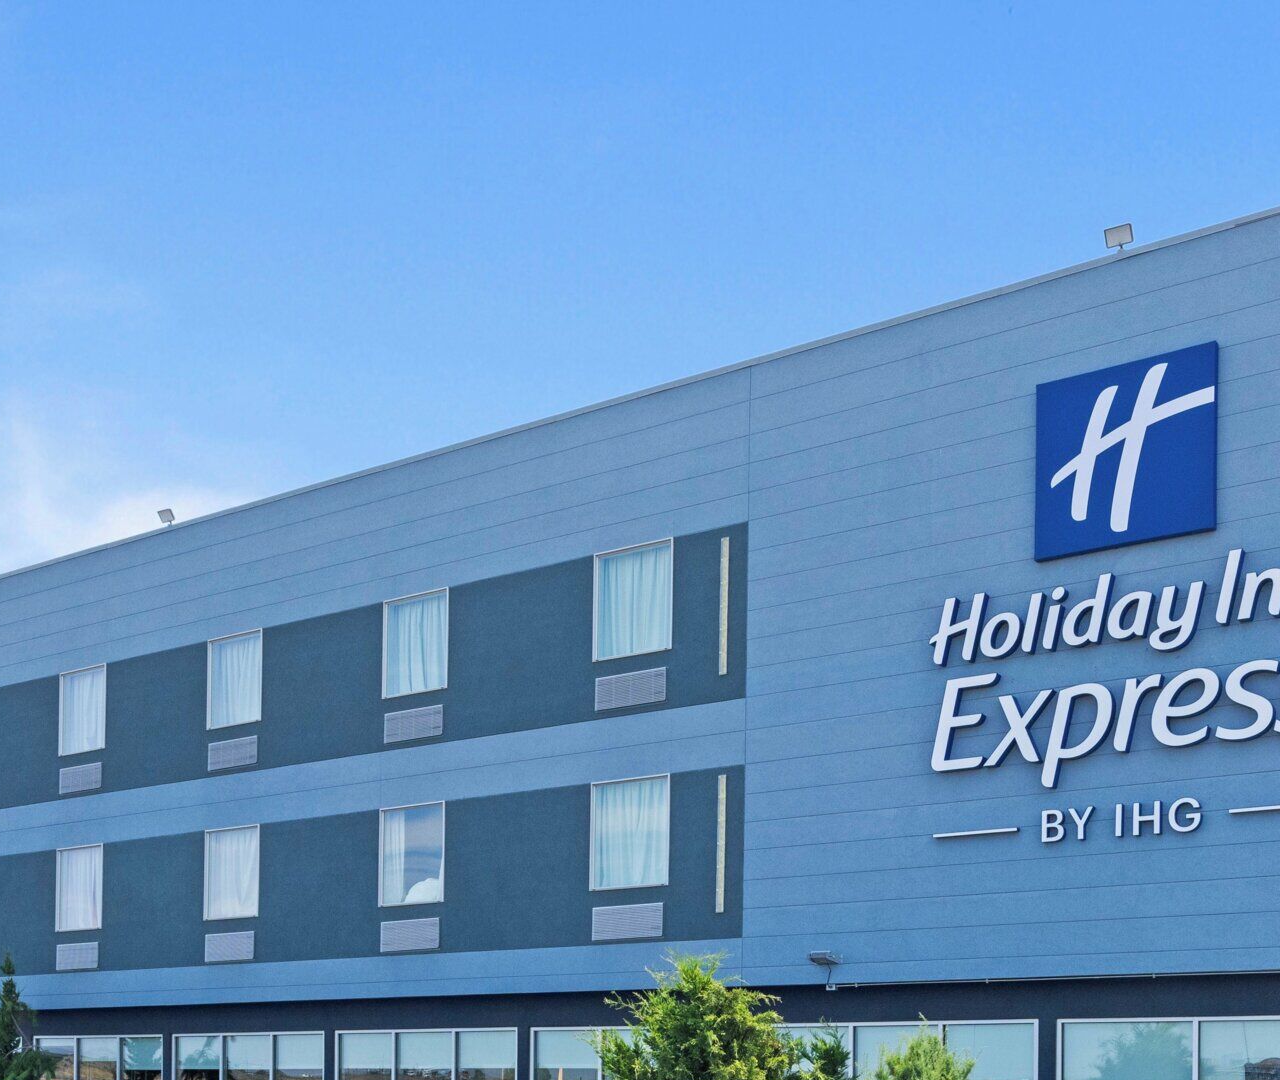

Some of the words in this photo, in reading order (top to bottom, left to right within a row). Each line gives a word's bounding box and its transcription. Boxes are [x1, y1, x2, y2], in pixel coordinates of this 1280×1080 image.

[929, 572, 1207, 666] Holiday
[1040, 805, 1096, 843] BY
[1114, 797, 1203, 838] IHG
